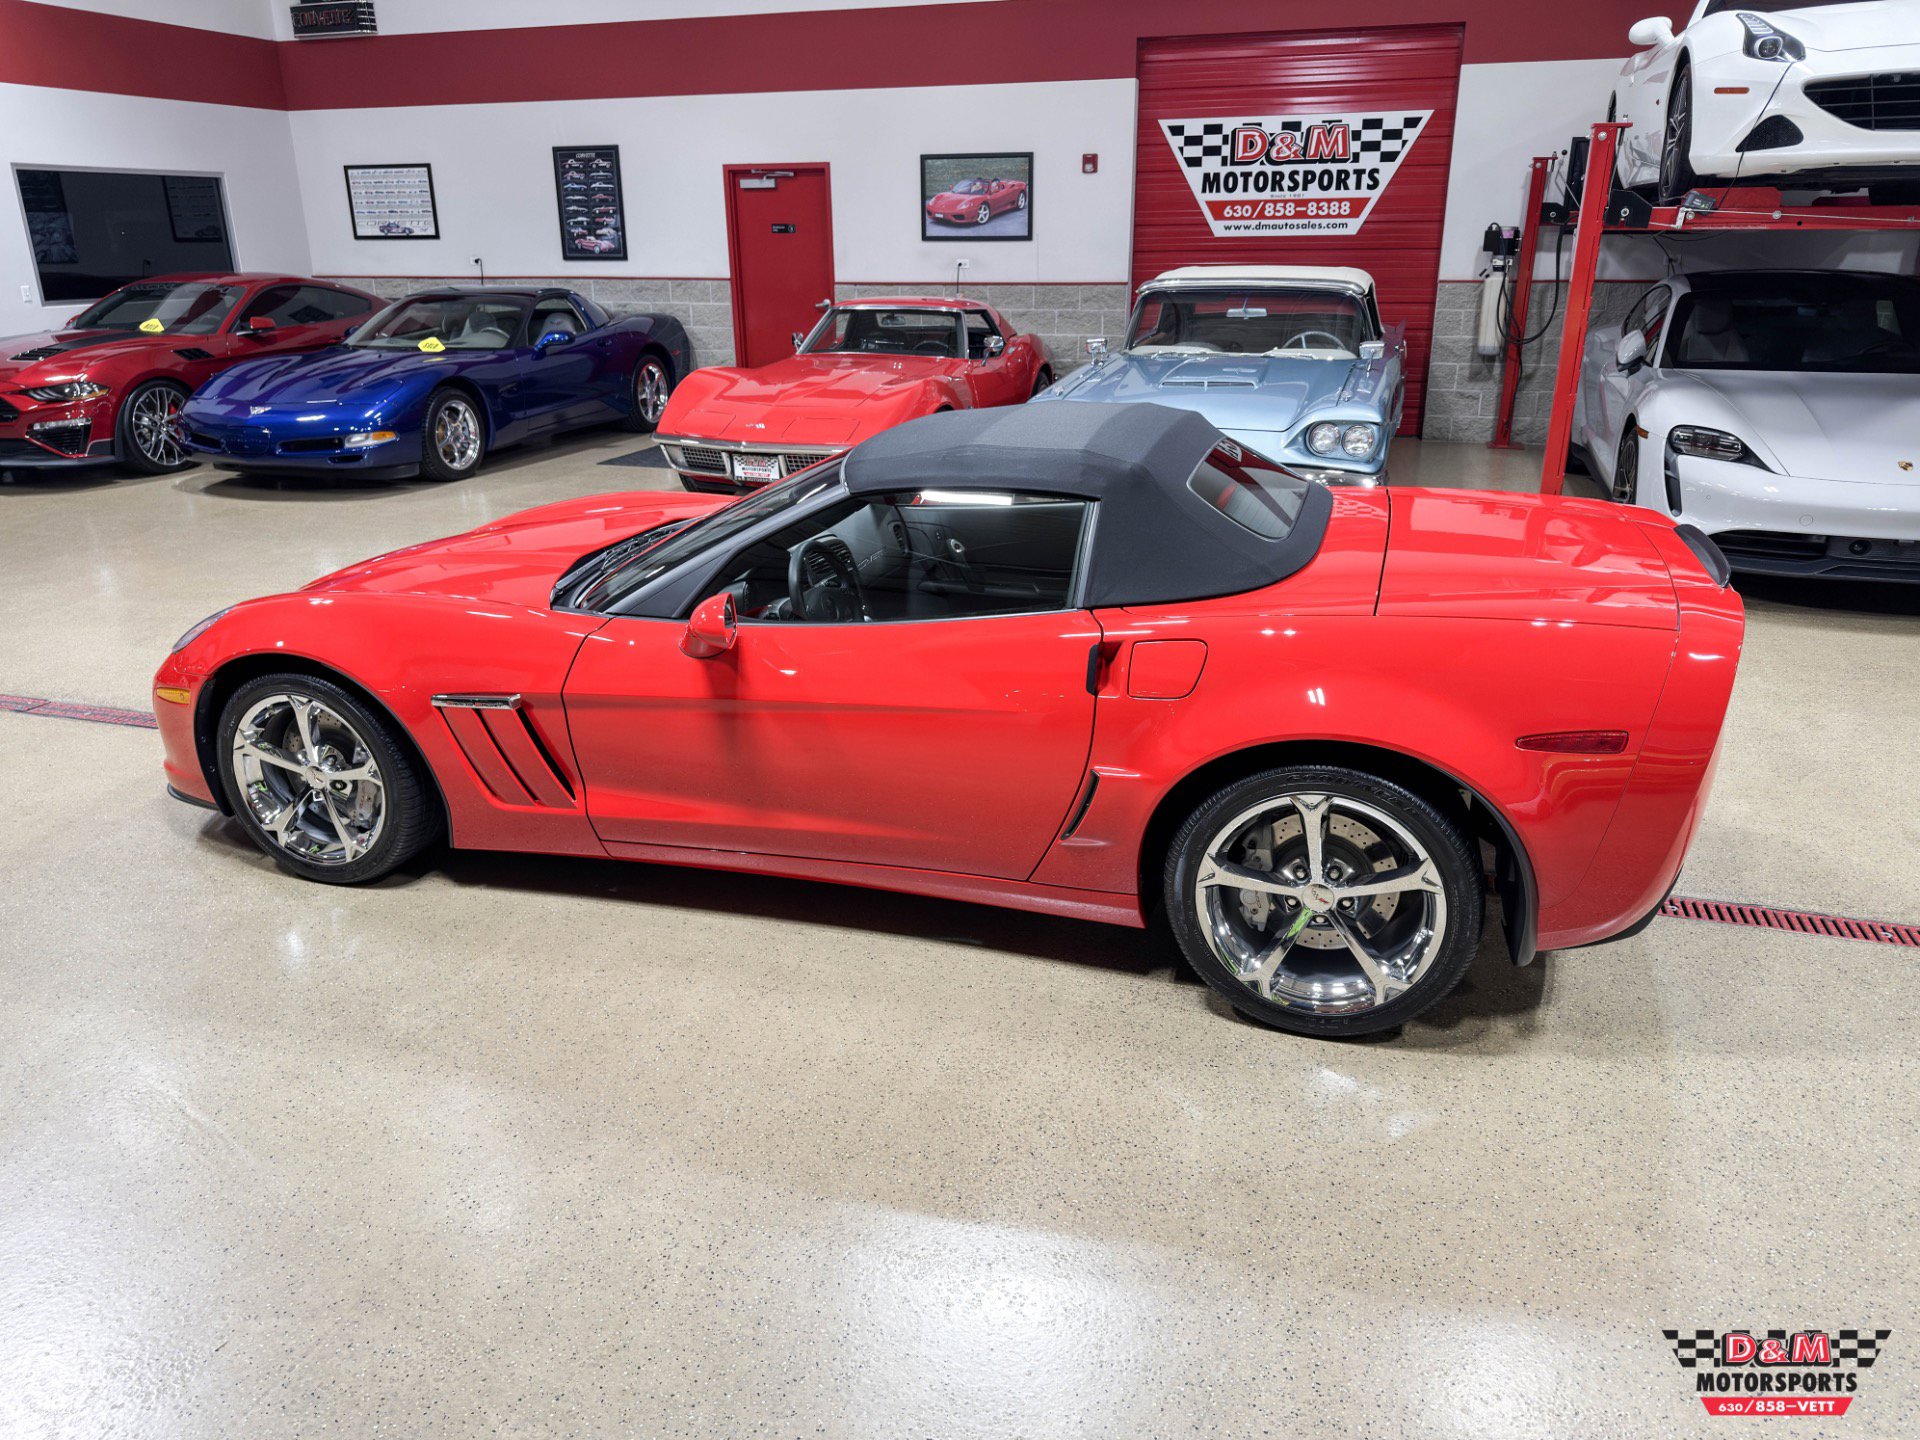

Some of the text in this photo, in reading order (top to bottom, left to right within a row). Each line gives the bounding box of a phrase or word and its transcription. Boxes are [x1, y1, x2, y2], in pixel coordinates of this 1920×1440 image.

[1230, 123, 1351, 166] D&M
[1201, 168, 1380, 194] MOTORSPORTS
[1223, 201, 1351, 219] 630/858-8388
[1223, 220, 1348, 231] www.dmautosales.com
